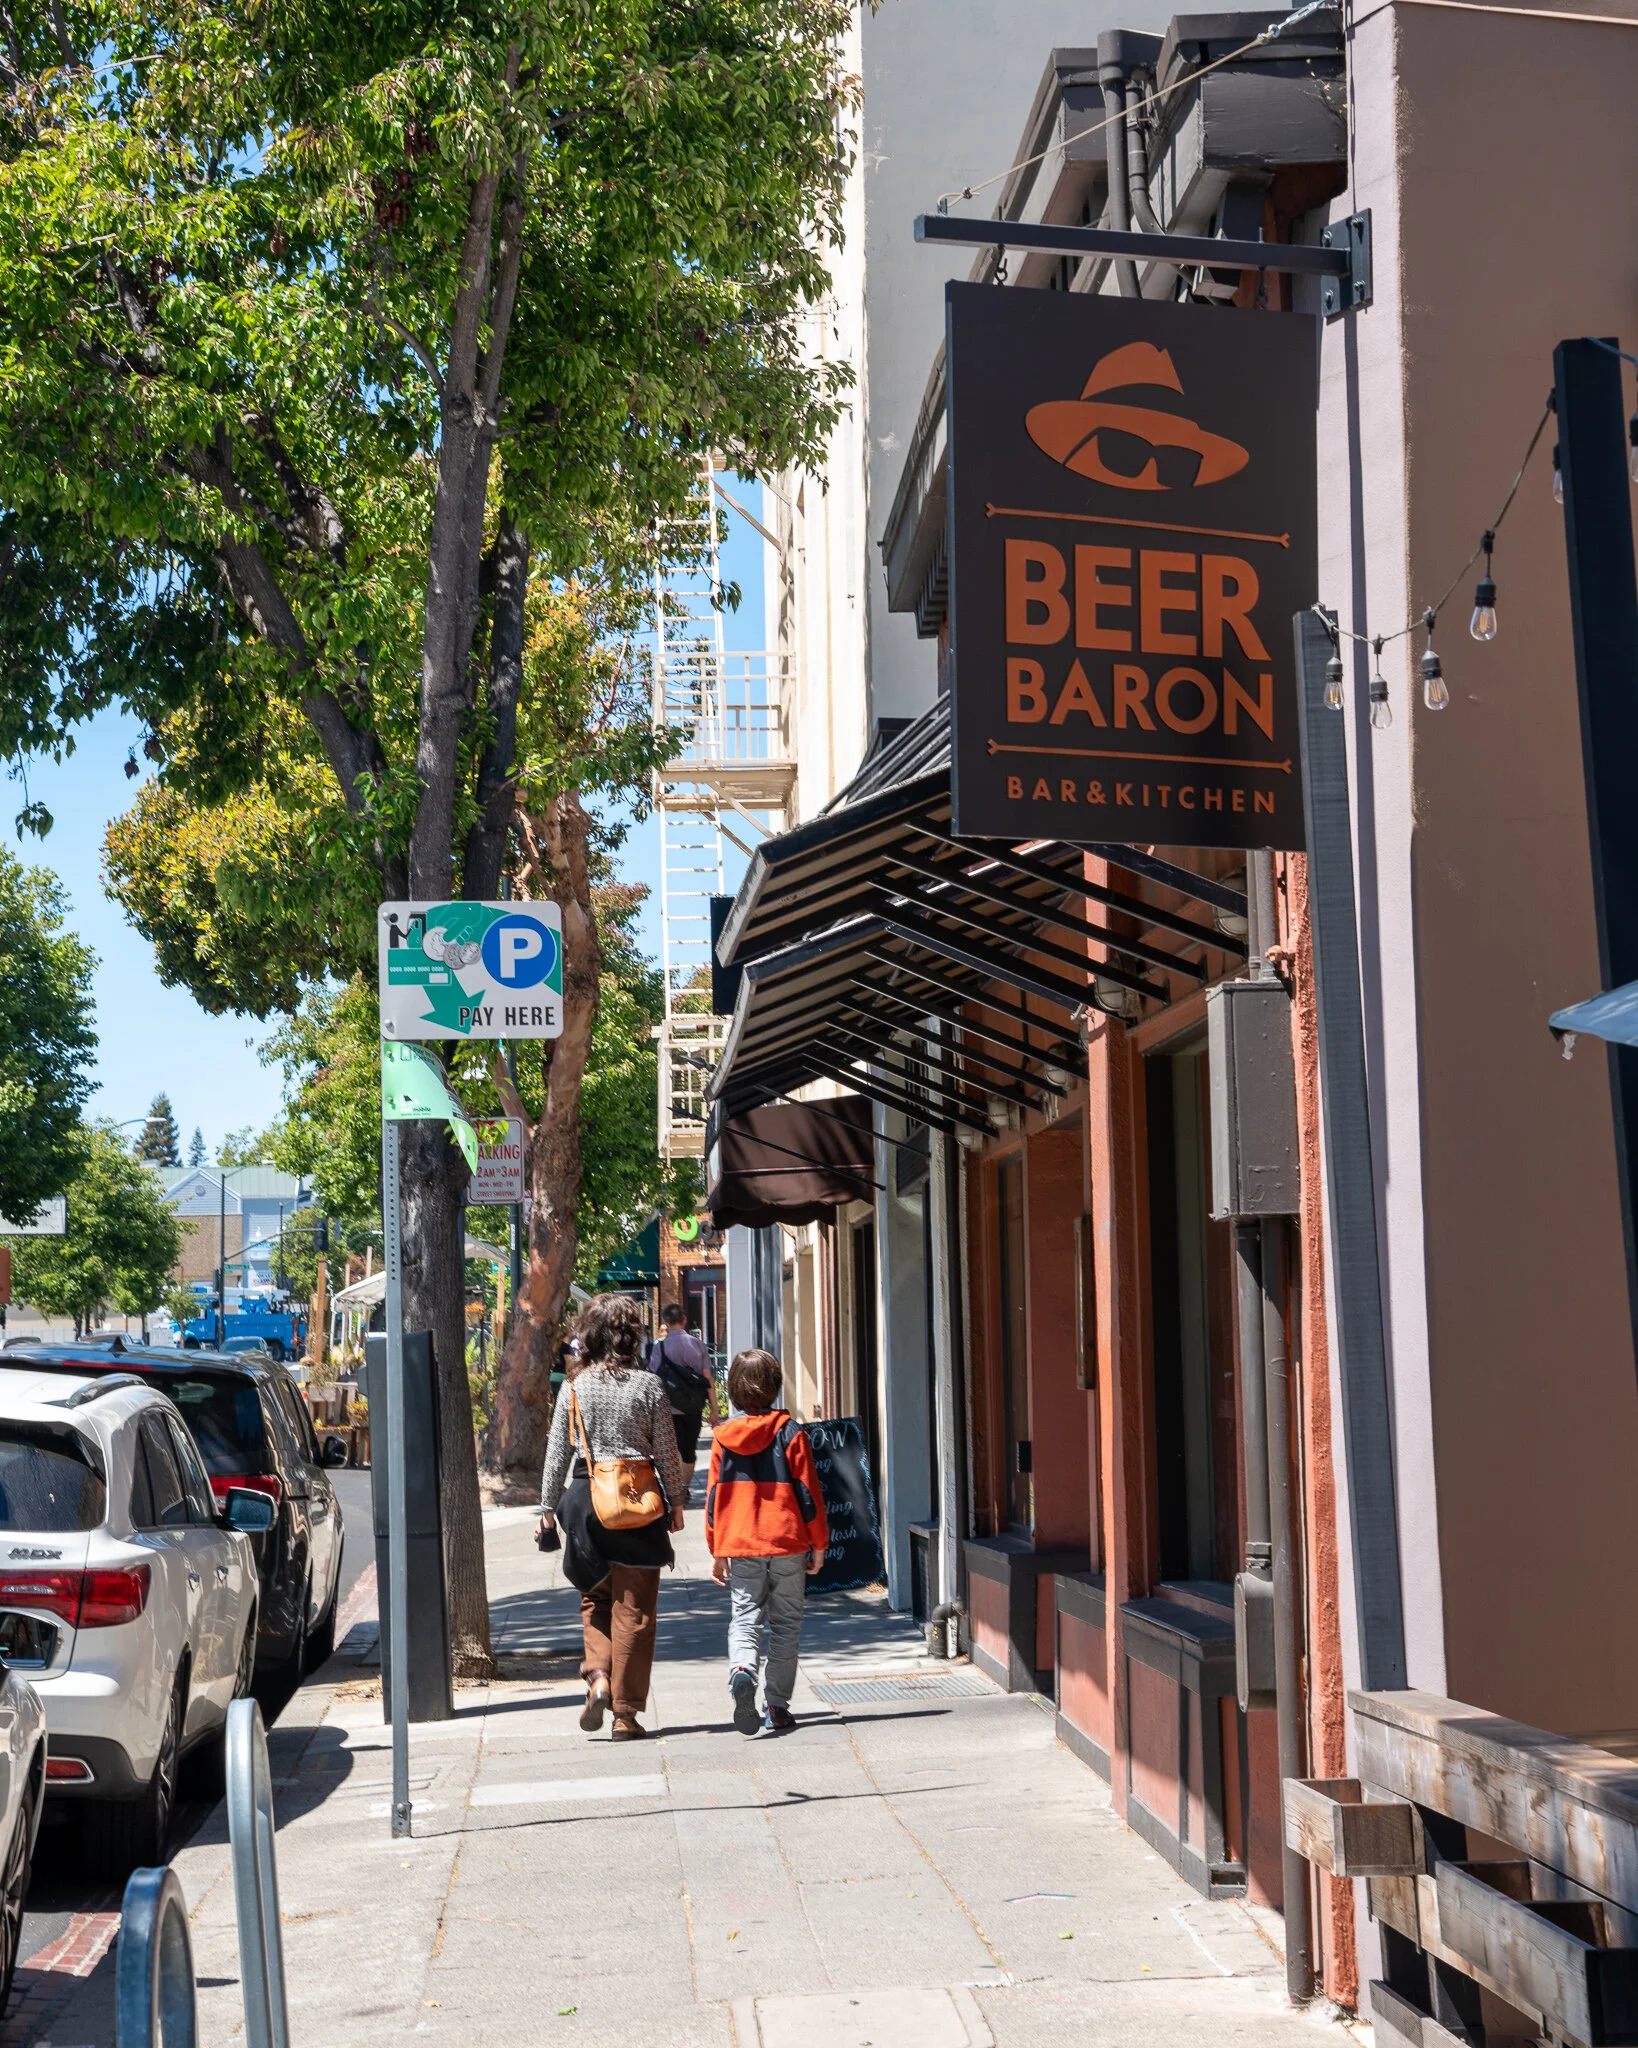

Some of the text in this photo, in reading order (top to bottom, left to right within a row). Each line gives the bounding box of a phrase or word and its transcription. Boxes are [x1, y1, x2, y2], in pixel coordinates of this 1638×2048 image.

[1005, 538, 1272, 661] BEER
[1006, 657, 1274, 742] BARON
[499, 928, 543, 979] P
[459, 1006, 556, 1026] PAY HERE
[478, 1144, 520, 1160] ARKING
[477, 1166, 496, 1178] 2AM
[501, 1165, 520, 1178] 3AM
[8, 1548, 62, 1560] MDX
